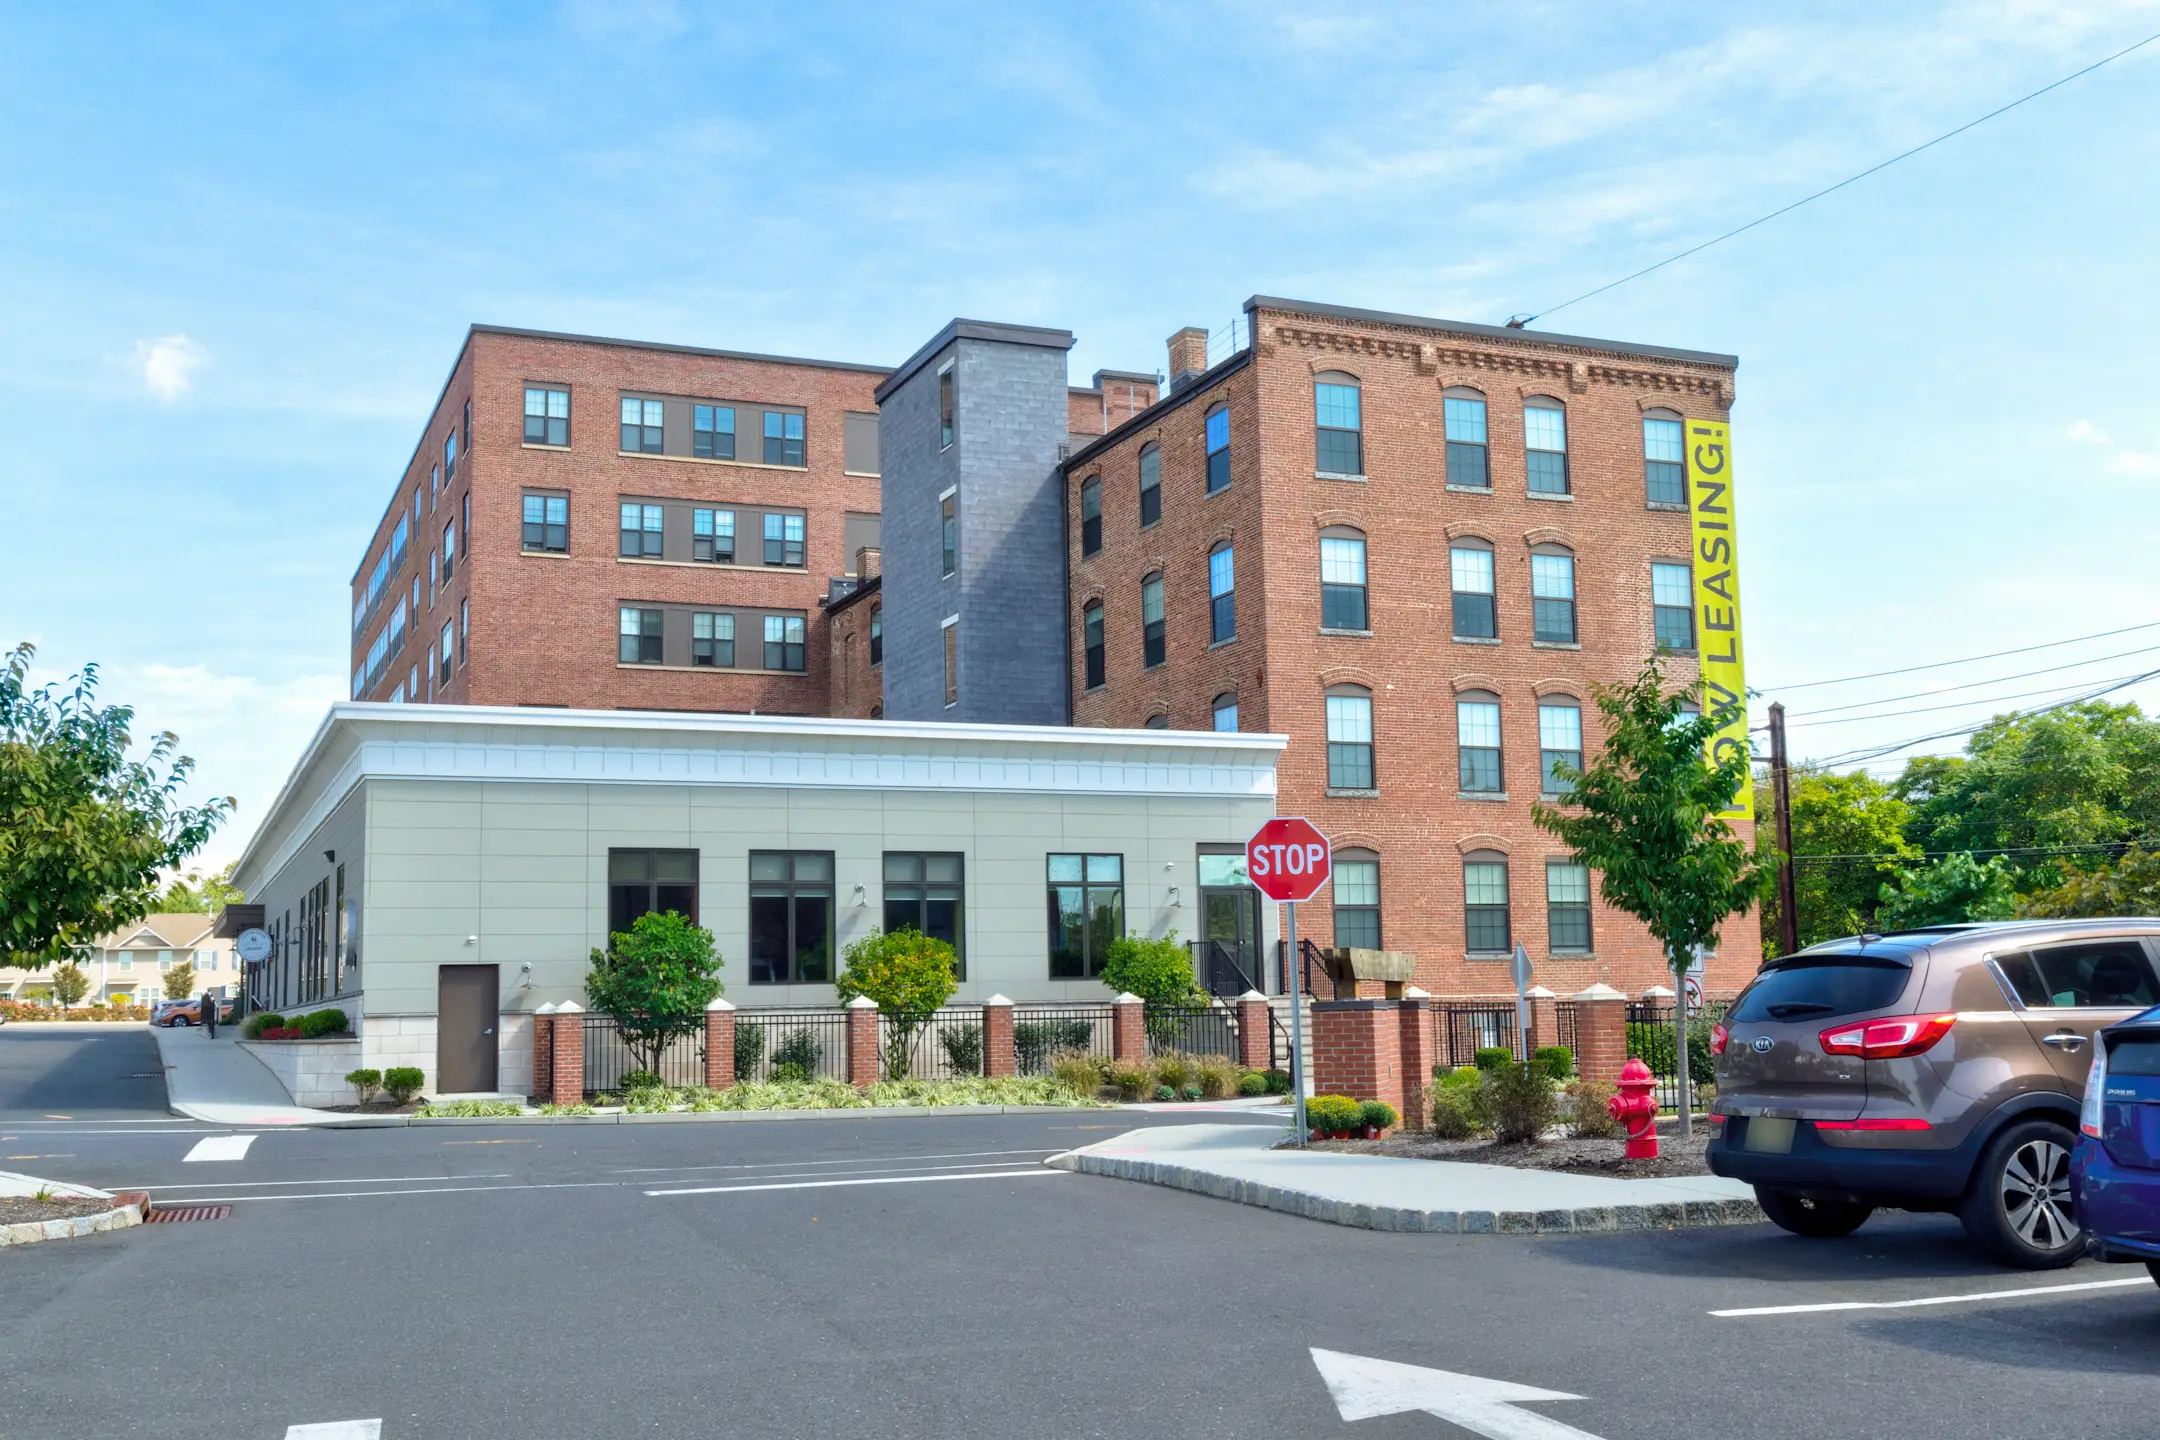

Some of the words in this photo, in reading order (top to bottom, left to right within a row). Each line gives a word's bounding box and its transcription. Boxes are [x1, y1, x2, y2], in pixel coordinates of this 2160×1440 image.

[1693, 427, 1737, 663] LEASING!
[1253, 844, 1324, 876] STOP
[2107, 1088, 2137, 1096] PRIUS
